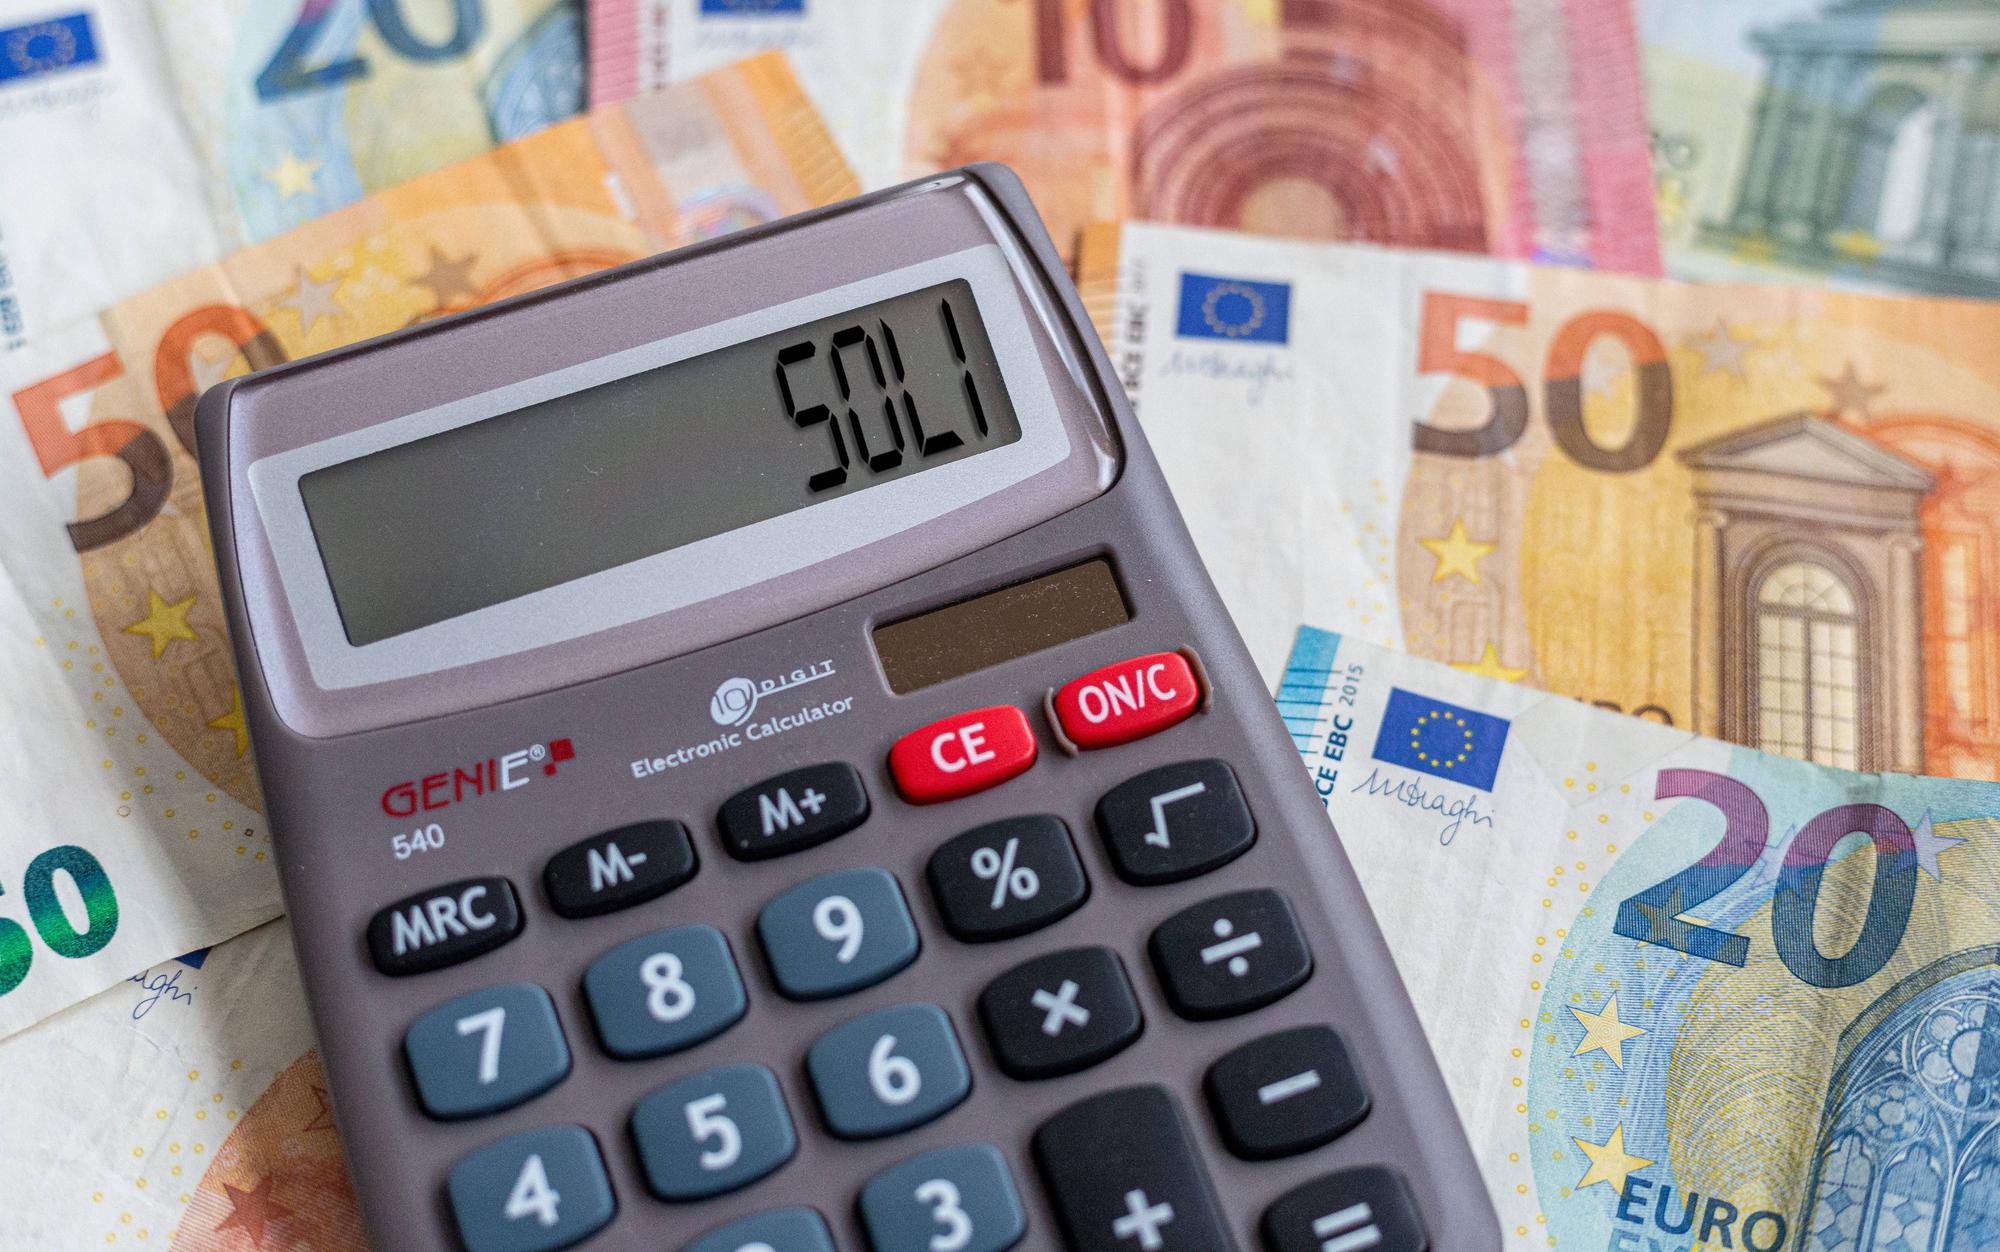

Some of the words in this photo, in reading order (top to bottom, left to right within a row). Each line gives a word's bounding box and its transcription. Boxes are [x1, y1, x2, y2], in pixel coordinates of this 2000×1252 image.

[1412, 291, 1673, 474] 50
[760, 659, 834, 692] DIGIT
[1077, 651, 1176, 725] ON/C
[630, 732, 742, 779] Electronic
[746, 697, 853, 741] Calculator
[929, 722, 996, 775] CE
[1323, 714, 1353, 762] EBC
[1339, 663, 1364, 708] 2015
[391, 823, 446, 861] 540
[757, 787, 827, 839] M+
[586, 842, 648, 893] M-
[970, 838, 1040, 910] %
[1613, 768, 1918, 989] 20
[389, 886, 498, 958] MRC
[812, 894, 864, 965] 9
[638, 951, 697, 1023] 8
[455, 1007, 506, 1085] 7
[868, 1033, 922, 1104] 6
[684, 1092, 742, 1170] 5
[503, 1153, 562, 1228] 4
[914, 1177, 974, 1251] 3
[1616, 1174, 1788, 1252] EURO
